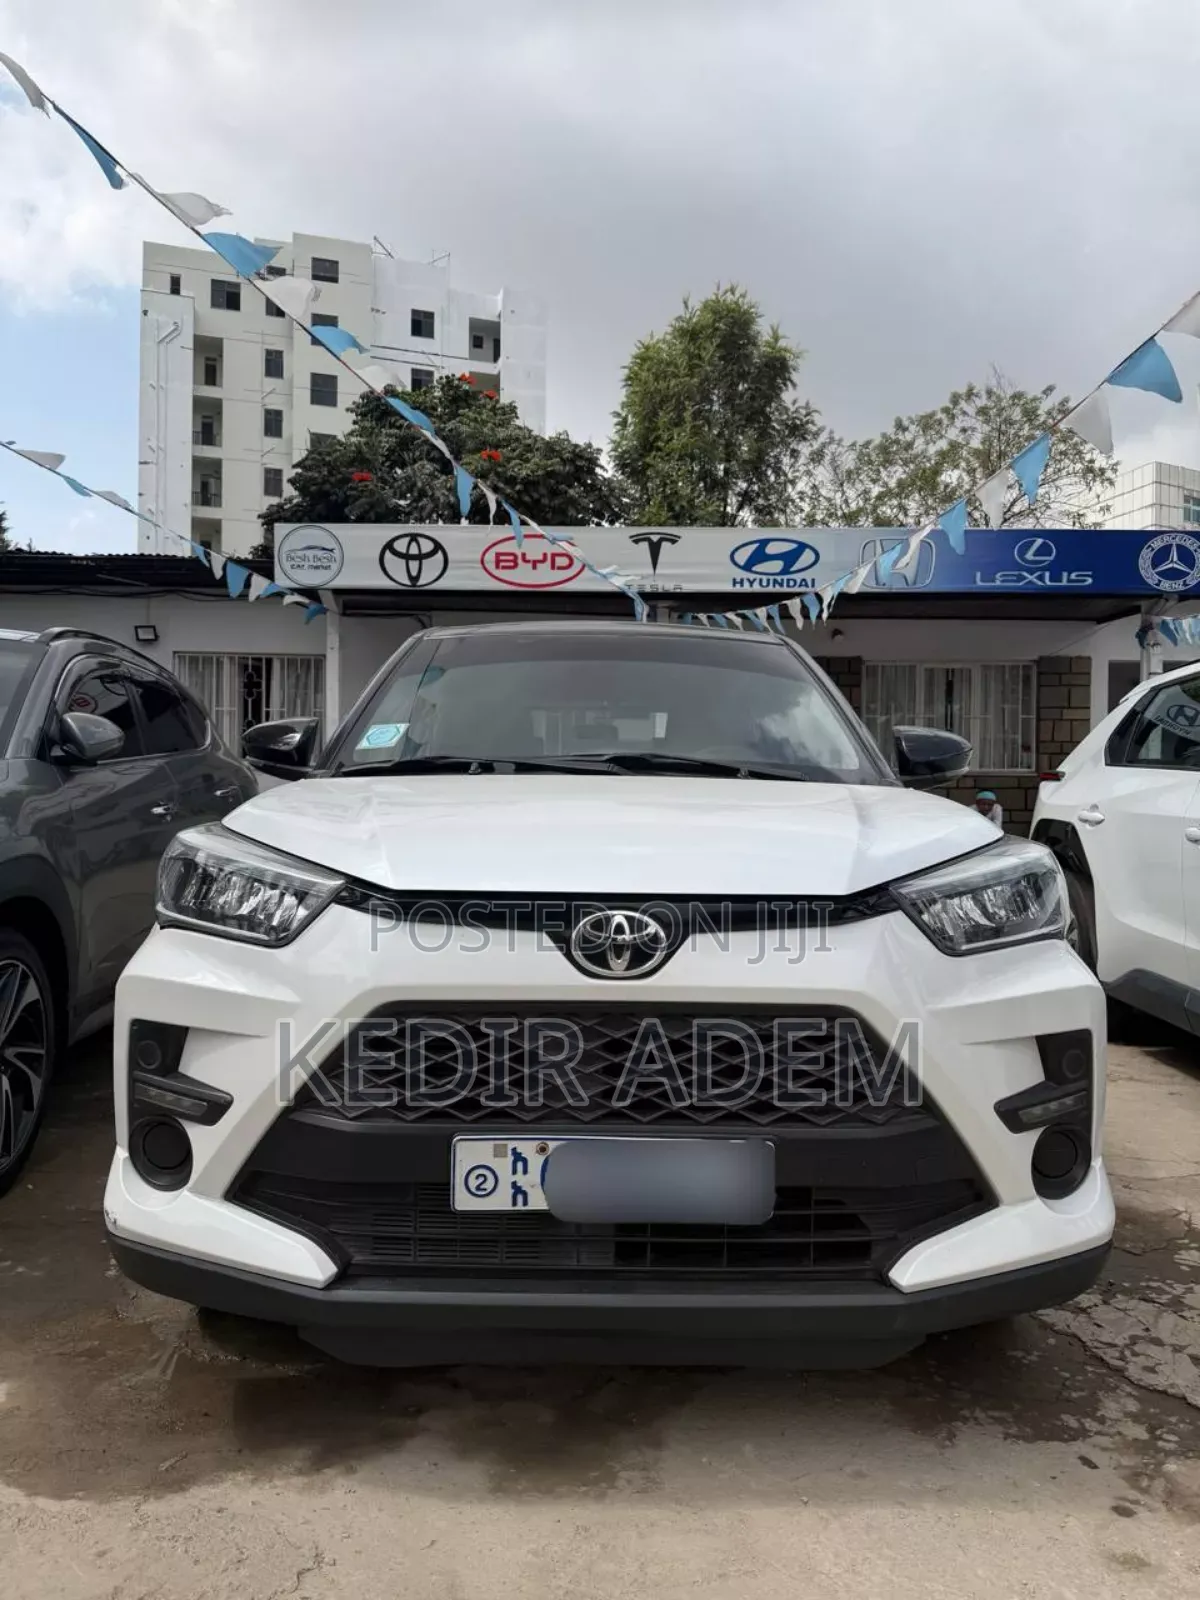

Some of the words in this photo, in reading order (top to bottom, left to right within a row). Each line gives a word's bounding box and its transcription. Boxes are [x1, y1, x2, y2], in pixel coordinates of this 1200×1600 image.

[494, 552, 574, 570] BYD
[732, 577, 816, 589] HYUNDAI
[975, 571, 1093, 586] LEXUS
